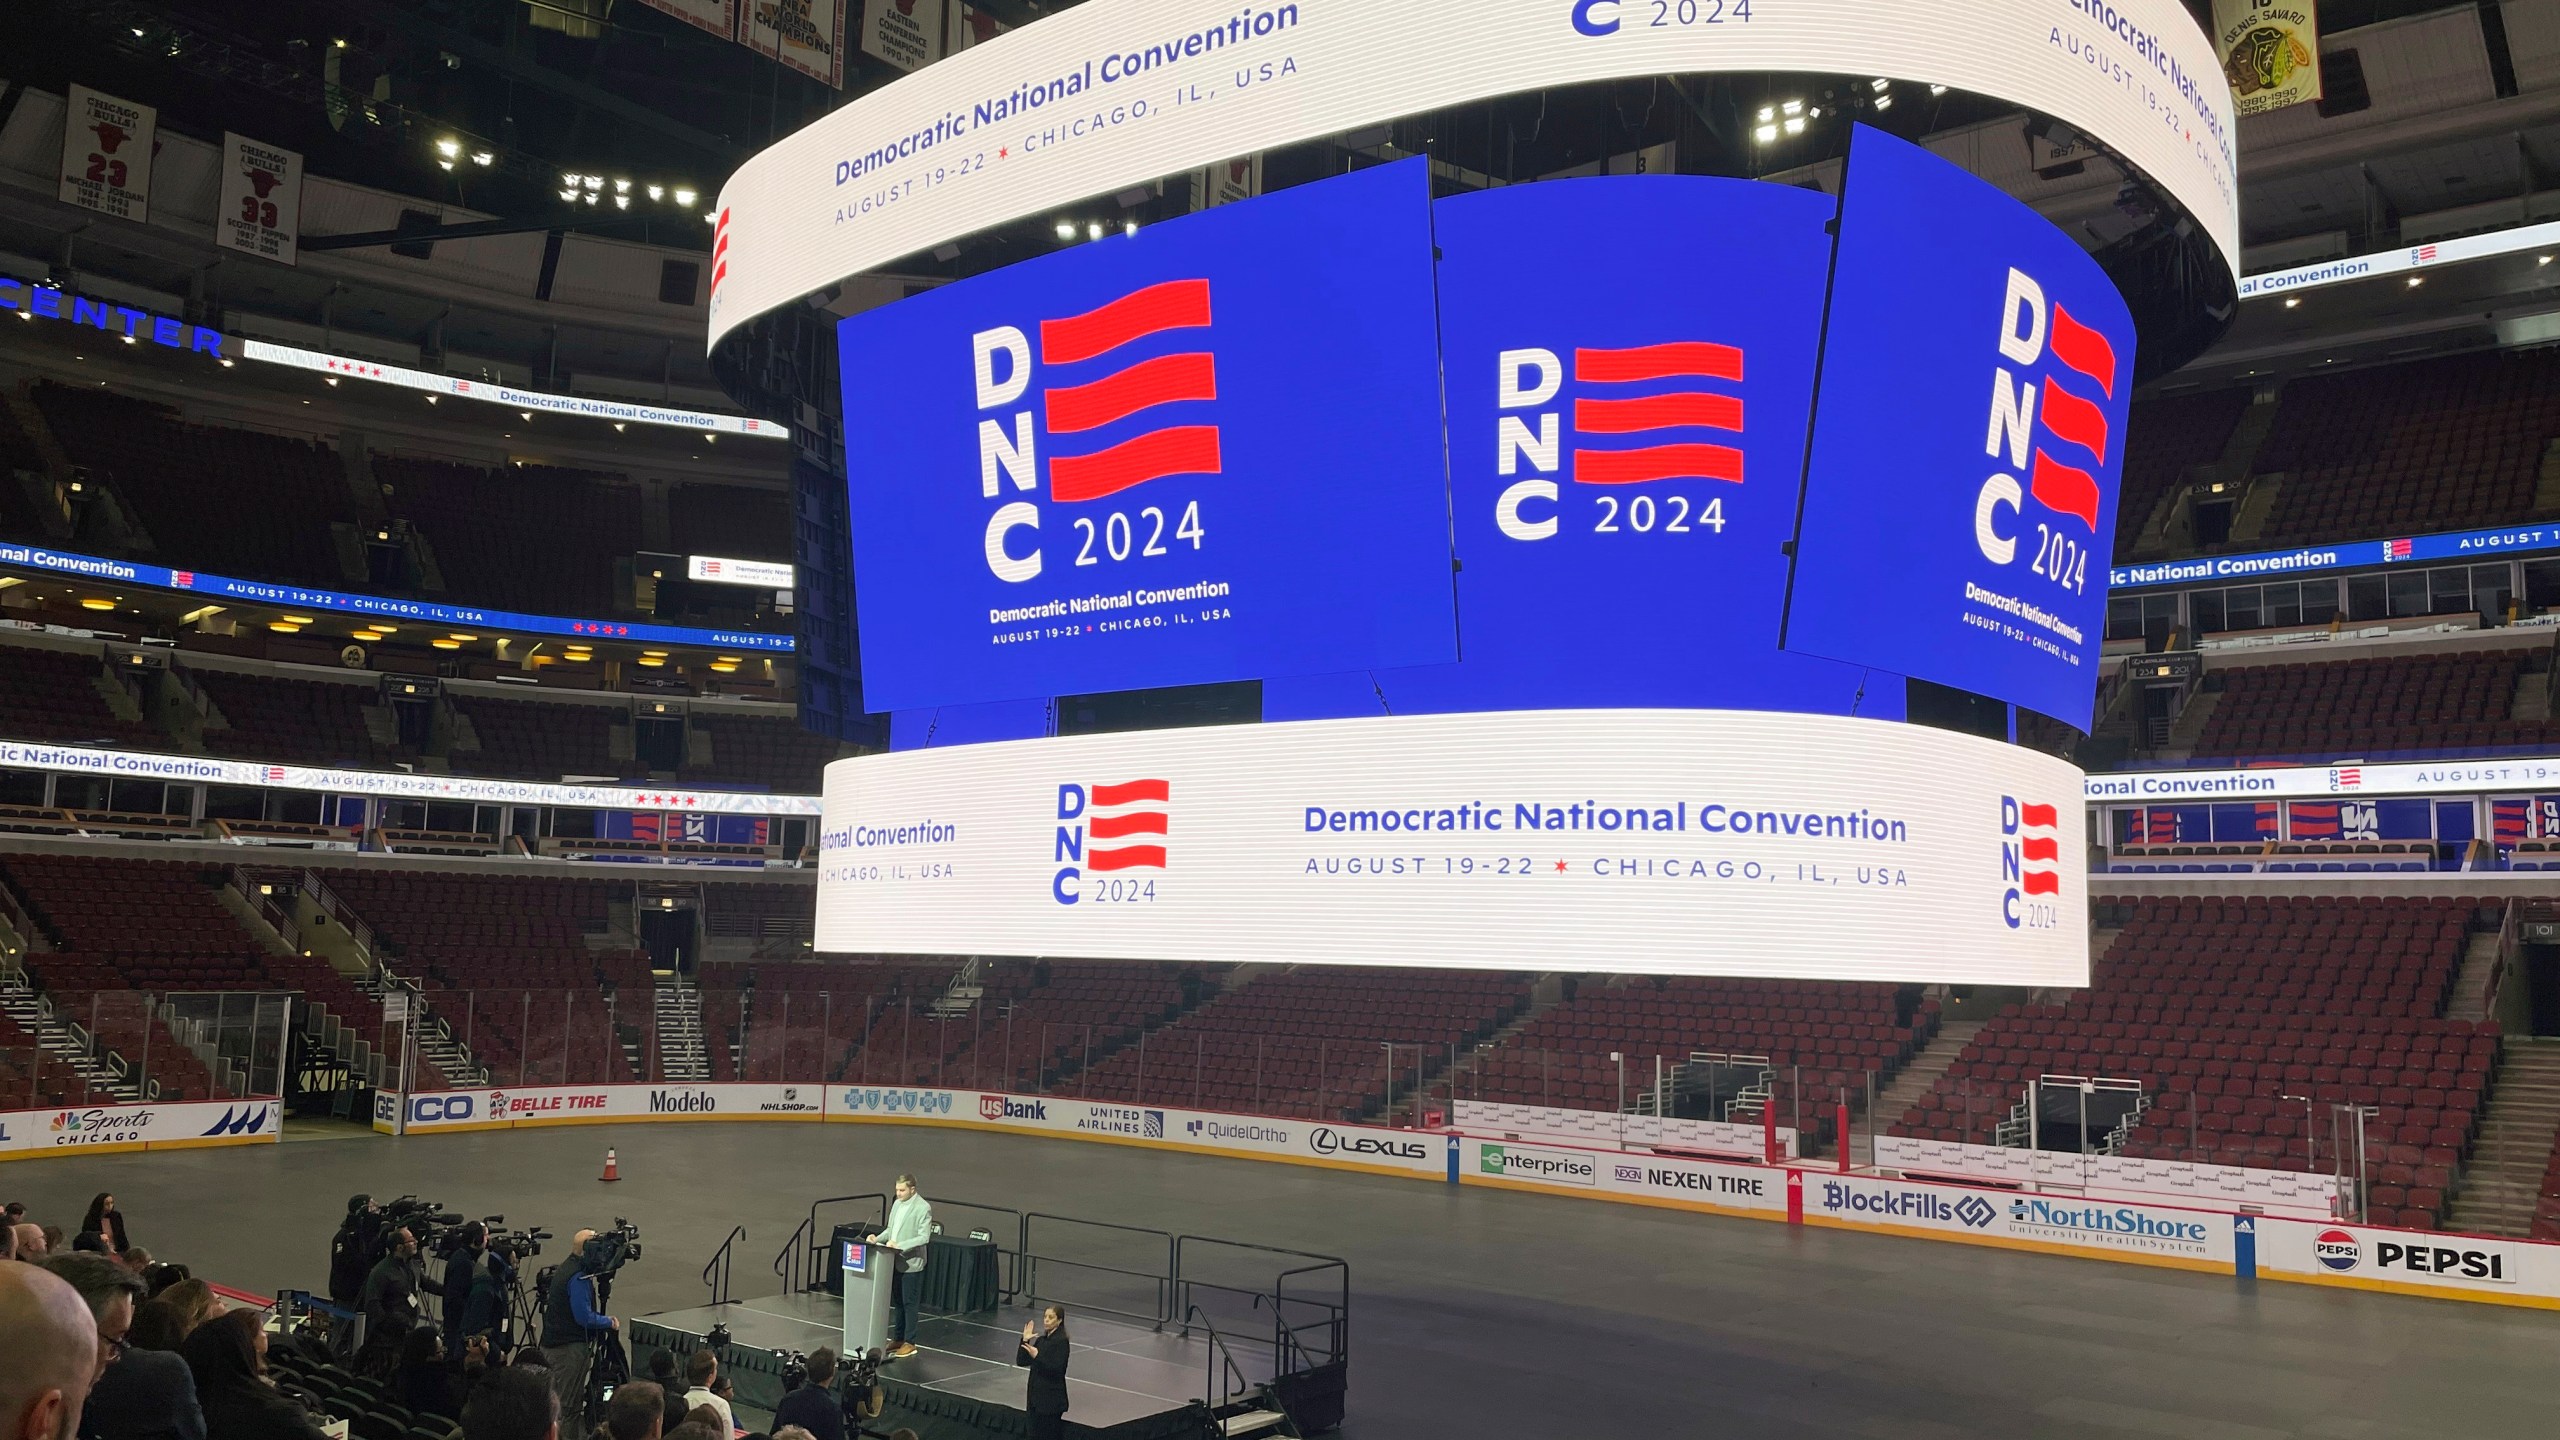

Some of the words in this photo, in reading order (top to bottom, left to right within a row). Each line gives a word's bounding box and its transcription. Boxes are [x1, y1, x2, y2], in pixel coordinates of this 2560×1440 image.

[771, 5, 817, 34] WORLD
[886, 9, 920, 32] EASTERN
[1650, 0, 1752, 26] 2024
[2224, 15, 2257, 44] DENIS
[2262, 9, 2305, 25] SAVARD
[755, 11, 831, 55] CHAMPIONS
[879, 17, 927, 48] CONFERENCE
[879, 30, 925, 60] CHAMPIONS
[882, 44, 916, 68] 1990-91
[2050, 27, 2132, 90] AUGUST
[2142, 84, 2179, 133] 19-22
[2070, 0, 2167, 76] mocratic
[2171, 56, 2217, 140] National
[87, 97, 139, 120] CHICAGO
[836, 112, 966, 187] Democratic
[973, 62, 1091, 130] National
[1101, 4, 1299, 84] Convention
[2240, 87, 2298, 108] 1980-1990
[2240, 96, 2297, 116] 1995-1997
[94, 111, 131, 127] BULLS
[240, 144, 287, 165] CHICAGO
[834, 180, 913, 225] AUGUST
[924, 153, 986, 189] 19-22
[1025, 100, 1158, 152] CHICAGO,
[1177, 84, 1216, 107] IL,
[1236, 57, 1298, 89] USA
[87, 153, 127, 188] 23
[247, 156, 281, 173] BULLS
[66, 174, 103, 192] MICHAEL
[108, 186, 145, 203] JORDAN
[242, 196, 278, 229] 33
[261, 228, 290, 243] PIPPEN
[2263, 261, 2369, 289] Convention
[500, 391, 577, 411] Democratic
[581, 402, 637, 418] National
[640, 406, 715, 427] Convention
[1975, 267, 2046, 565] DNC
[973, 326, 1042, 583] DNC
[1496, 348, 1562, 541] DNC
[1594, 496, 1726, 533] 2024
[1073, 500, 1205, 566] 2024
[2460, 532, 2542, 549] AUGUST
[34, 551, 135, 578] Convention
[2032, 523, 2087, 596] 2024
[2384, 541, 2392, 562] DNC
[735, 566, 774, 575] Democratic
[2109, 568, 2126, 585] ic
[2130, 564, 2212, 583] National
[2217, 551, 2336, 575] Convention
[227, 583, 285, 599] AUGUST
[293, 591, 333, 604] 19-22
[355, 599, 424, 616] CHICAGO,
[432, 608, 450, 620] IL,
[457, 612, 483, 622] USA
[990, 599, 1067, 624] Democratic
[1070, 591, 1132, 615] National
[1135, 581, 1229, 606] Convention
[1965, 582, 2021, 617] Democratic
[2021, 598, 2053, 630] National
[2052, 614, 2082, 645] Convention
[713, 634, 763, 645] AUGUST
[992, 630, 1040, 645] AUGUST
[1046, 626, 1080, 639] 19-22
[1100, 616, 1167, 633] CHICAGO,
[1174, 613, 1194, 624] IL,
[1202, 608, 1231, 622] USA
[1963, 611, 2000, 633] AUGUST
[2003, 624, 2024, 641] 19-22
[2032, 636, 2061, 659] CHICAGO,
[2069, 652, 2079, 667] USA
[1, 745, 18, 762] ic
[24, 749, 108, 768] National
[114, 757, 222, 777] Convention
[321, 776, 385, 788] AUGUST
[394, 779, 436, 791] 19-22
[460, 785, 533, 799] CHICAGO,
[568, 791, 597, 801] USA
[2084, 775, 2135, 795] ional
[2143, 774, 2276, 794] Convention
[2330, 769, 2338, 791] DNC
[2417, 769, 2511, 783] AUGUST
[856, 819, 955, 848] Convention
[1305, 801, 1502, 832] Democratic
[1514, 800, 1686, 832] National
[1700, 803, 1907, 842] Convention
[1053, 783, 1085, 905] DNC
[825, 866, 884, 883] CHICAGO,
[892, 866, 912, 881] IL,
[921, 863, 953, 879] USA
[1305, 857, 1426, 875] AUGUST
[1445, 857, 1533, 875] 19-22
[1593, 857, 1776, 882] CHICAGO,
[1798, 863, 1838, 885] IL,
[1857, 867, 1907, 887] USA
[2001, 795, 2020, 929] DNC
[1095, 878, 1156, 902] 2024
[2029, 904, 2057, 929] 2024
[2536, 925, 2553, 936] 101
[510, 1096, 562, 1112] BELLE
[568, 1095, 608, 1109] TIRE
[650, 1090, 715, 1112] Modelo
[1091, 1107, 1140, 1121] UNITED
[82, 1110, 154, 1134] Sports
[1078, 1119, 1139, 1133] AIRLINES
[1208, 1122, 1287, 1143] QuidelOrtho
[56, 1132, 138, 1145] CHICAGO
[1341, 1136, 1426, 1159] LEXUS
[1484, 1152, 1592, 1177] enterprise
[1648, 1169, 1711, 1191] NEXEN
[1717, 1175, 1763, 1196] TIRE
[2009, 1224, 2087, 1242] University
[2030, 1199, 2207, 1240] NorthShore
[2317, 1243, 2358, 1257] PEPSI
[2377, 1242, 2502, 1279] PEPSI
